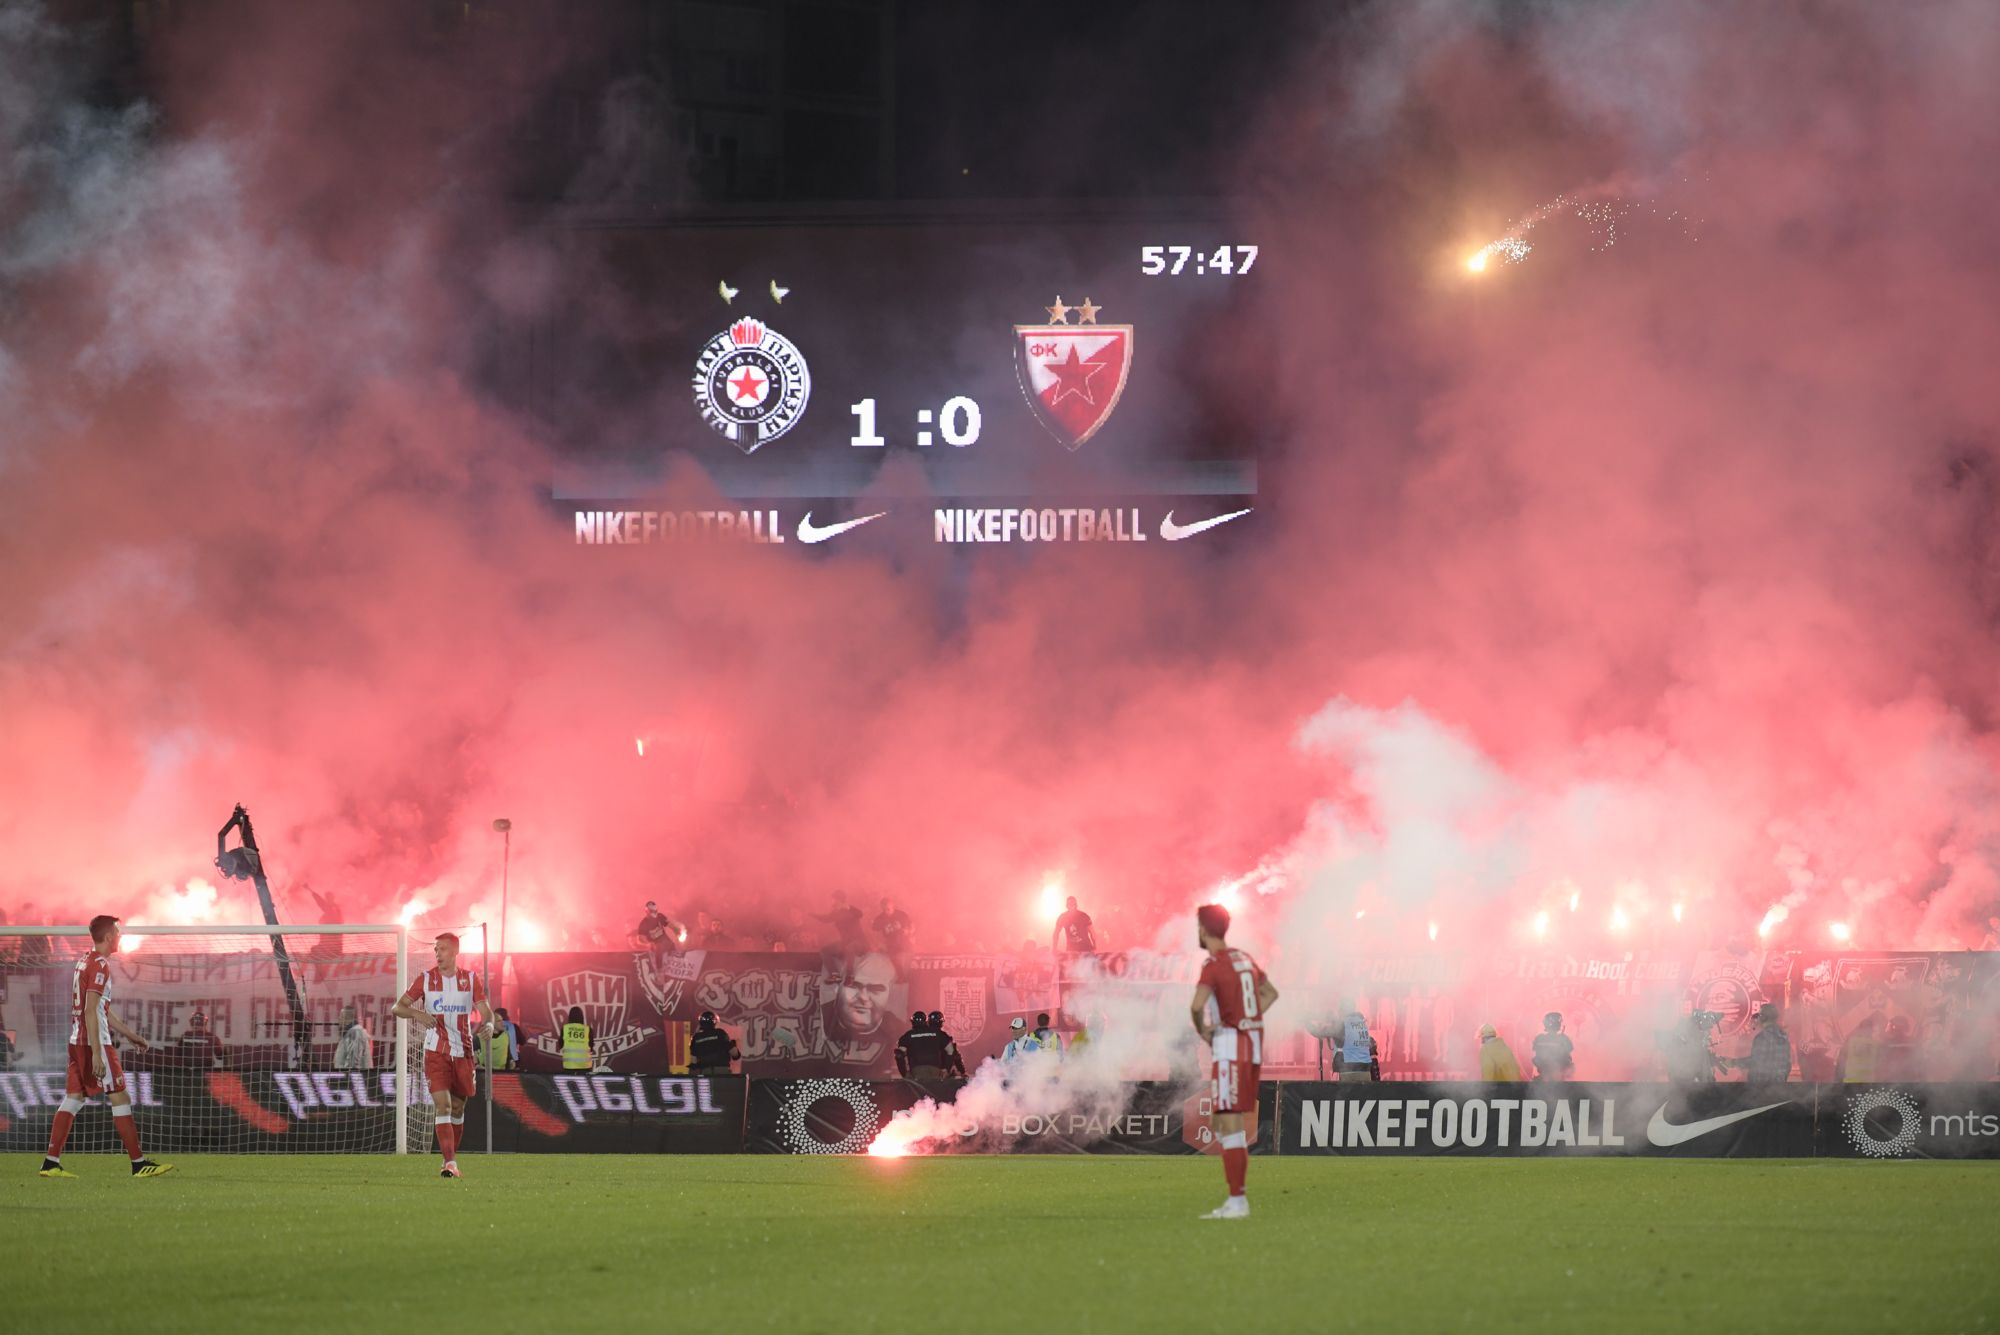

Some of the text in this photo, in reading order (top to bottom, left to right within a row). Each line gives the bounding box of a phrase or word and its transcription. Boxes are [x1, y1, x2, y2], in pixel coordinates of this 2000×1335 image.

[1142, 245, 1258, 276] 57:47
[1030, 343, 1058, 357] ФК
[850, 398, 885, 446] 1
[575, 511, 785, 546] NIKEFOOTBALL
[935, 508, 1146, 543] NIKEFOOTBALL
[1240, 971, 1258, 1018] 8
[552, 1004, 624, 1039] РМИ
[1002, 1114, 1060, 1136] BOX
[1068, 1114, 1169, 1136] PAKETI
[1300, 1098, 1625, 1147] NIKEFOOTBALL
[1930, 1110, 2000, 1136] mts
